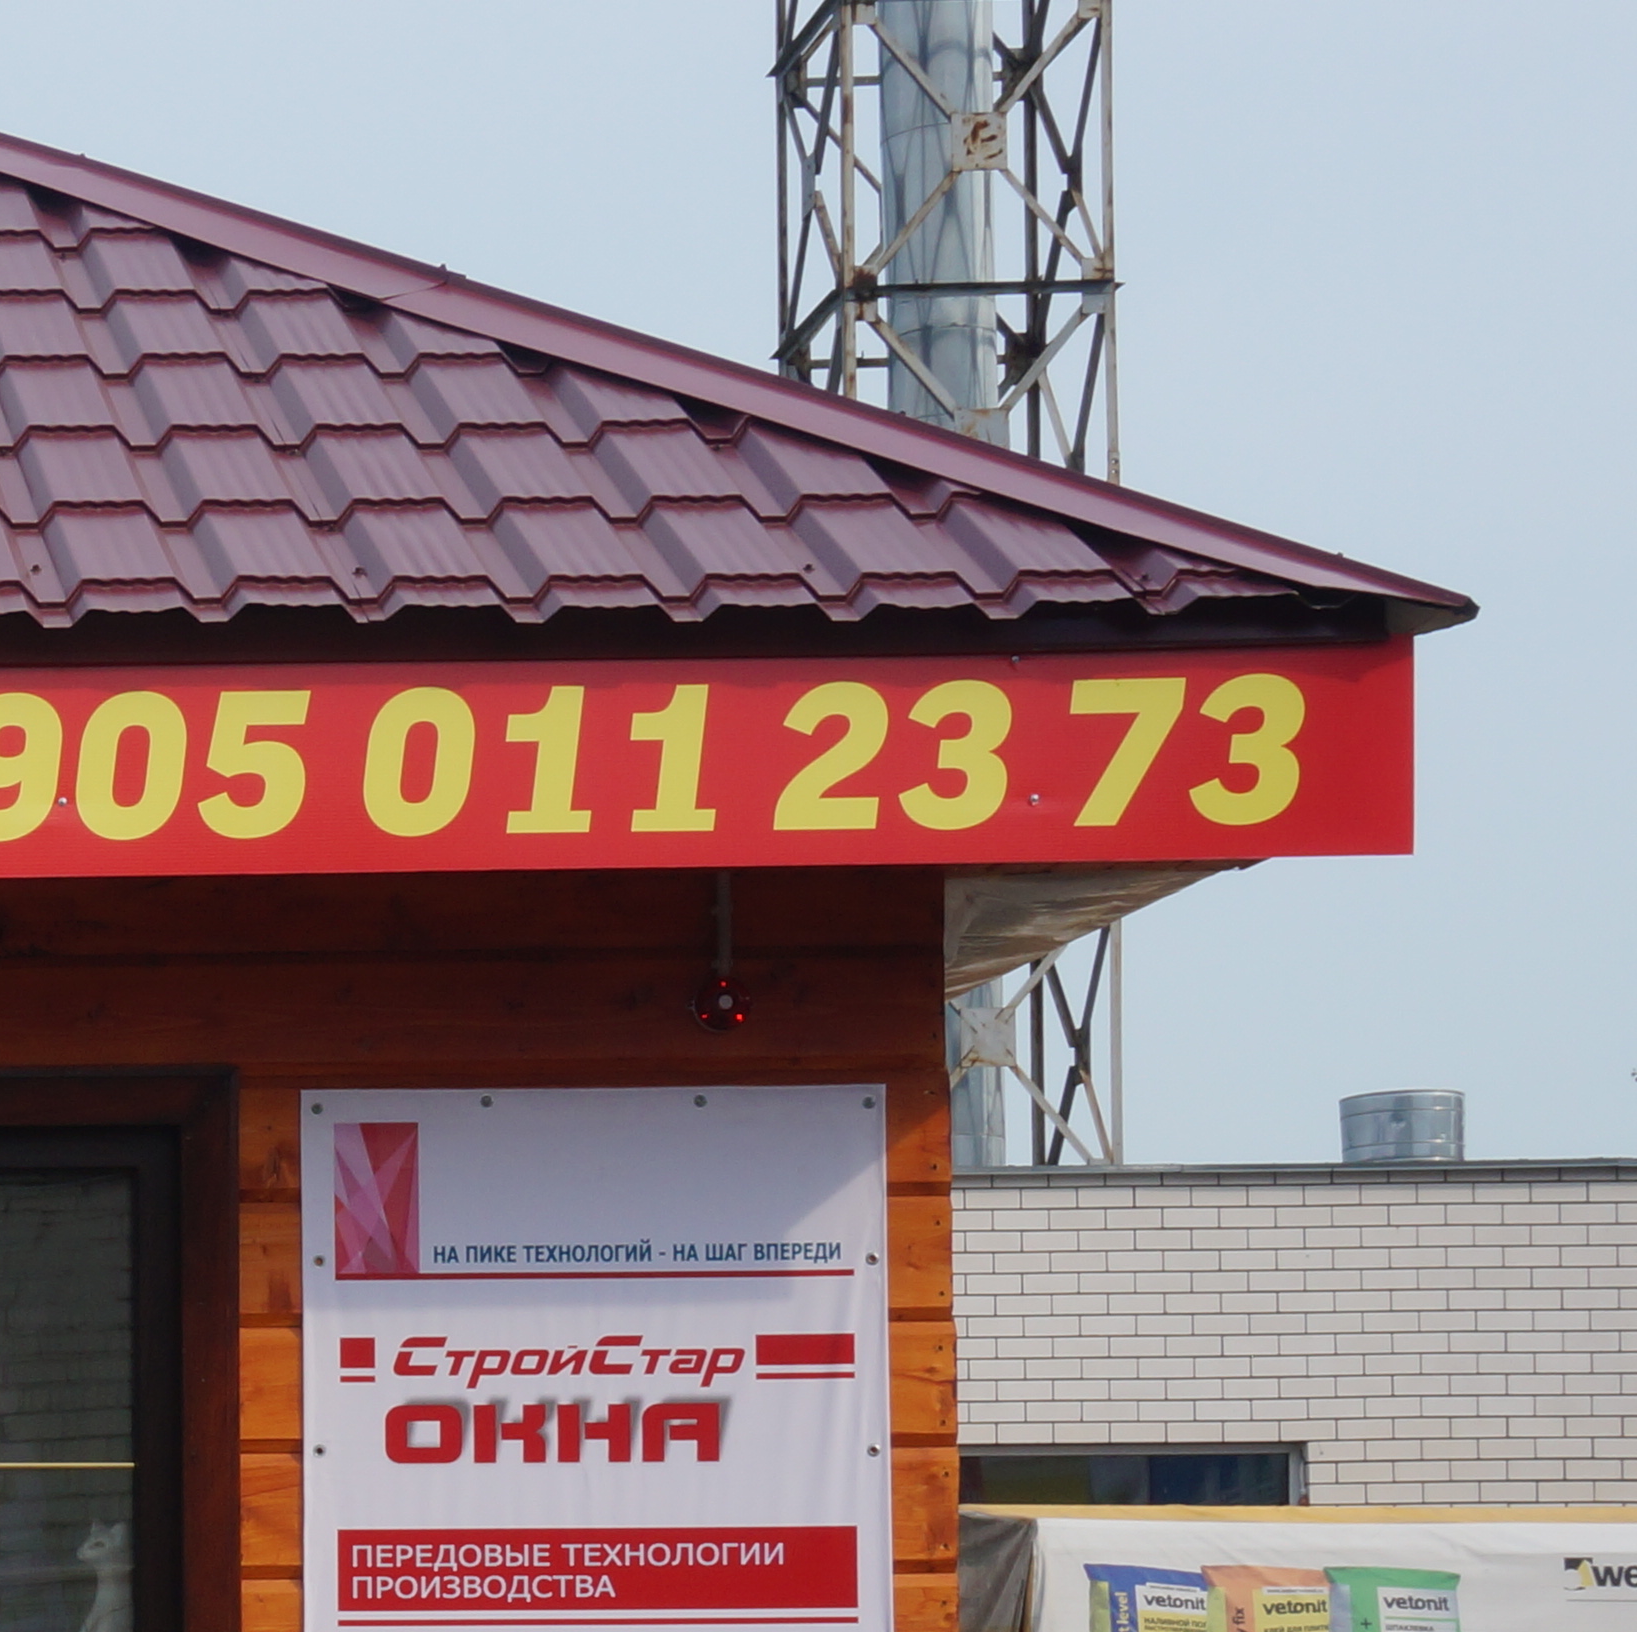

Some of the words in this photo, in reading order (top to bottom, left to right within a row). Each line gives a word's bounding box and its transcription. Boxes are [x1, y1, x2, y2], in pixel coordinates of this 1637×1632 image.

[363, 684, 716, 837] 011
[773, 680, 1012, 830] 23
[1070, 674, 1305, 826] 73
[434, 1246, 459, 1263] НА
[466, 1245, 516, 1262] ПИКЕ
[523, 1239, 651, 1262] ТЕХНОЛОГИЙ
[673, 1244, 698, 1261] НА
[706, 1244, 747, 1261] ШАГ
[754, 1243, 840, 1262] ВПЕРЕДИ
[393, 1336, 745, 1388] СтройСтар
[385, 1403, 721, 1464] ОКНА
[353, 1544, 550, 1572] ПЕРЕДОВЫЕ
[561, 1543, 784, 1566] ТЕХНОЛОГИИ
[353, 1575, 615, 1602] ПРОИЗВОДСТВА
[1144, 1594, 1206, 1610] vetonit
[1115, 1592, 1130, 1624] level
[1233, 1606, 1245, 1625] fix
[1262, 1599, 1328, 1616] vetonit
[1383, 1597, 1449, 1611] vetonit
